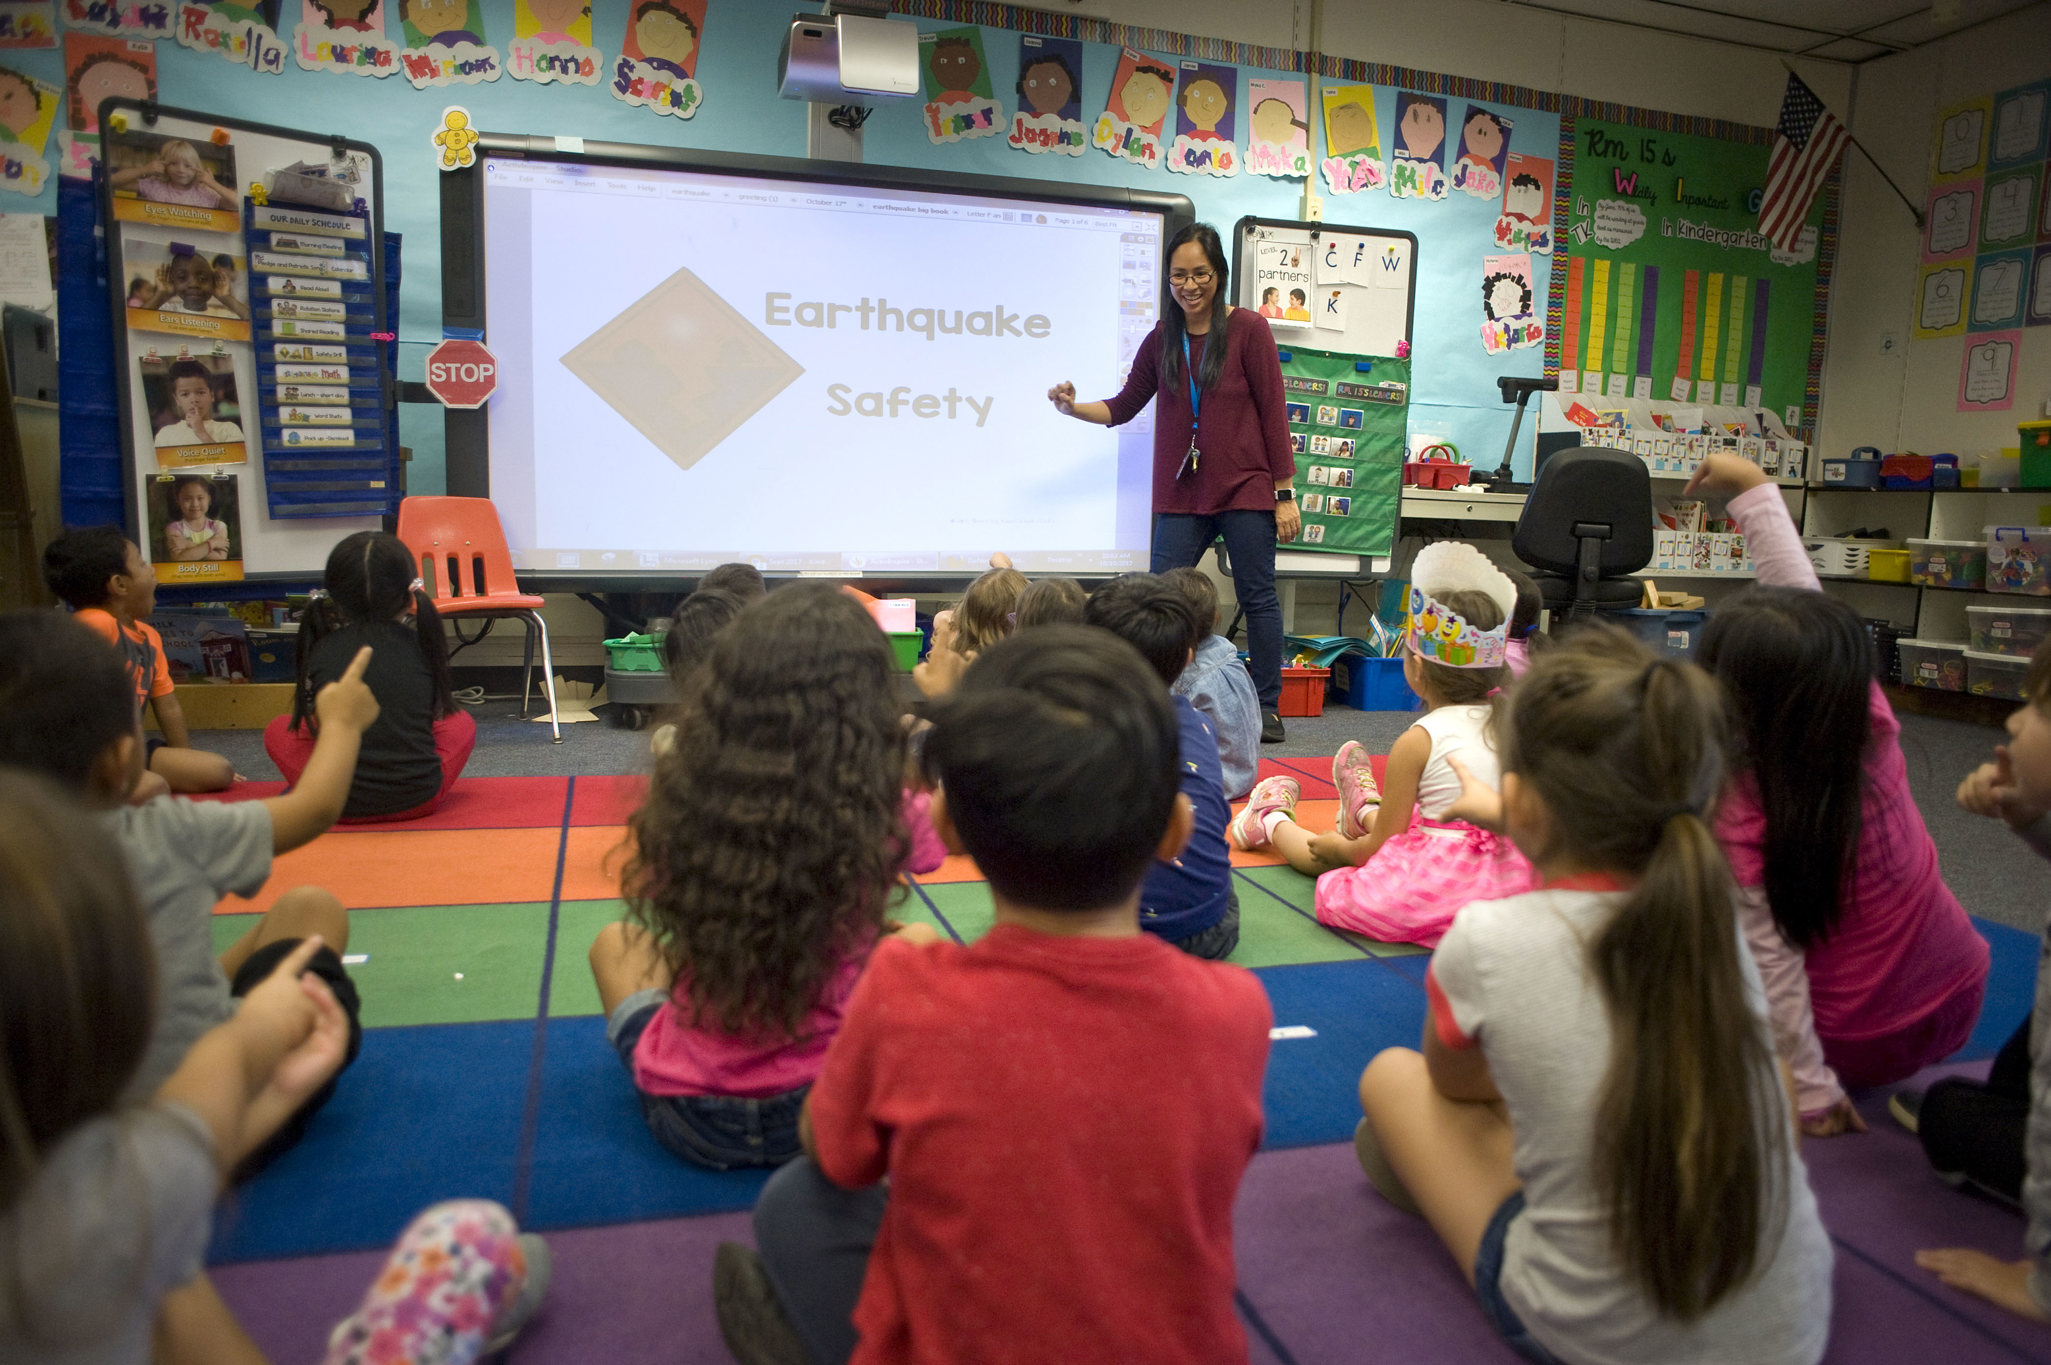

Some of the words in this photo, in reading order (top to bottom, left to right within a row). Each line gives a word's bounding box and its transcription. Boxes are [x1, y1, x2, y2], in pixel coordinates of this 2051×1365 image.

[1584, 128, 1629, 161] Rm
[806, 198, 832, 206] October
[872, 204, 917, 212] earthquake
[917, 206, 929, 214] big
[1577, 196, 1589, 215] In
[144, 203, 167, 214] Eyes
[169, 206, 212, 221] Watching
[1055, 217, 1070, 225] Page
[270, 214, 288, 223] OUR
[290, 217, 311, 226] DAILY
[312, 218, 351, 230] SCHEDULE
[1571, 219, 1593, 244] TK
[1662, 218, 1673, 236] In
[1679, 219, 1767, 249] Kindergarten
[1279, 249, 1289, 266] 2
[1325, 251, 1338, 268] C
[1353, 252, 1363, 267] F
[1382, 256, 1401, 272] W
[1258, 269, 1309, 284] partners
[1991, 266, 2009, 290] 7
[1935, 276, 1950, 298] 6
[1327, 298, 1338, 314] K
[160, 314, 179, 323] Ears
[181, 316, 220, 329] Listening
[765, 292, 1051, 341] Earthquake
[1982, 348, 1997, 371] 9
[321, 368, 342, 380] Math
[431, 362, 494, 383] STOP
[827, 383, 994, 427] Safety
[176, 448, 200, 457] Voice
[201, 447, 226, 456] Quiet
[178, 564, 201, 575] Body
